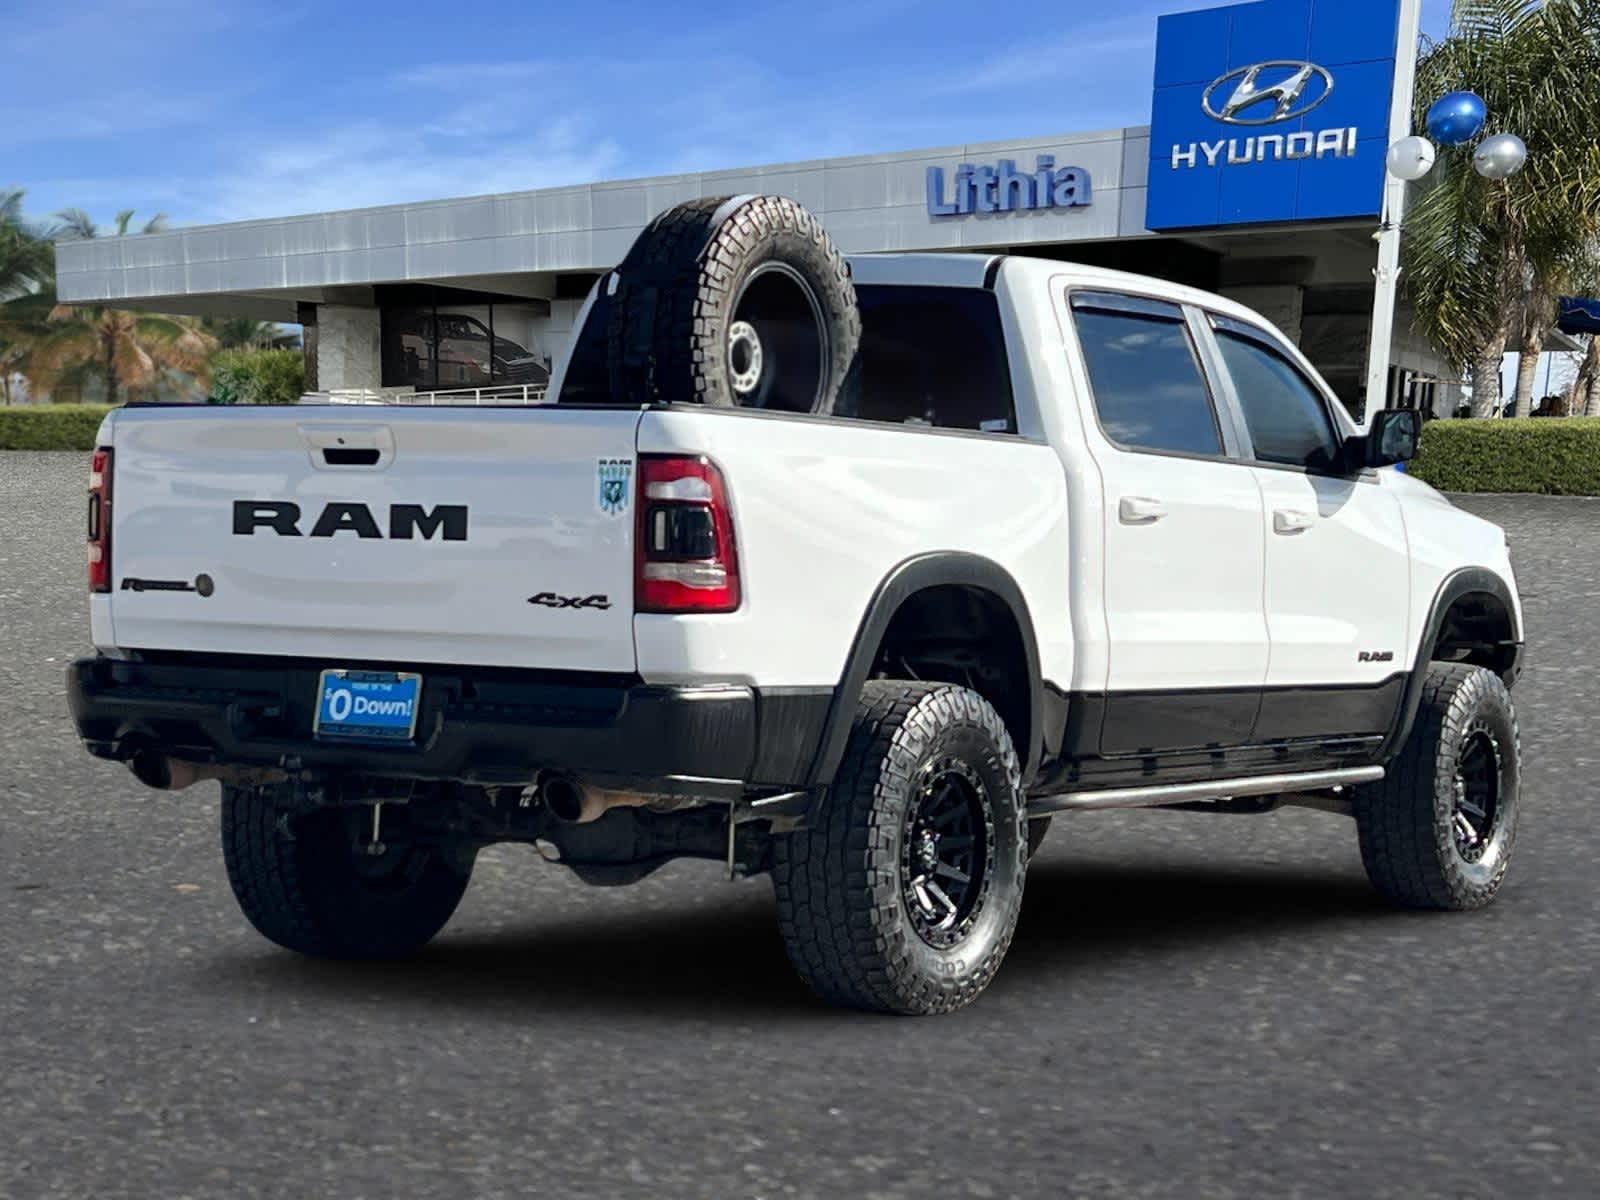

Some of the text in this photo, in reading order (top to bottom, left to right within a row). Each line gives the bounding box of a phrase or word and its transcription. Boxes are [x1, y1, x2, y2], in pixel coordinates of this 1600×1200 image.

[1171, 126, 1357, 169] HYUNDAI
[926, 155, 1092, 217] Lithia
[232, 500, 468, 541] RAM
[353, 696, 413, 717] Down!
